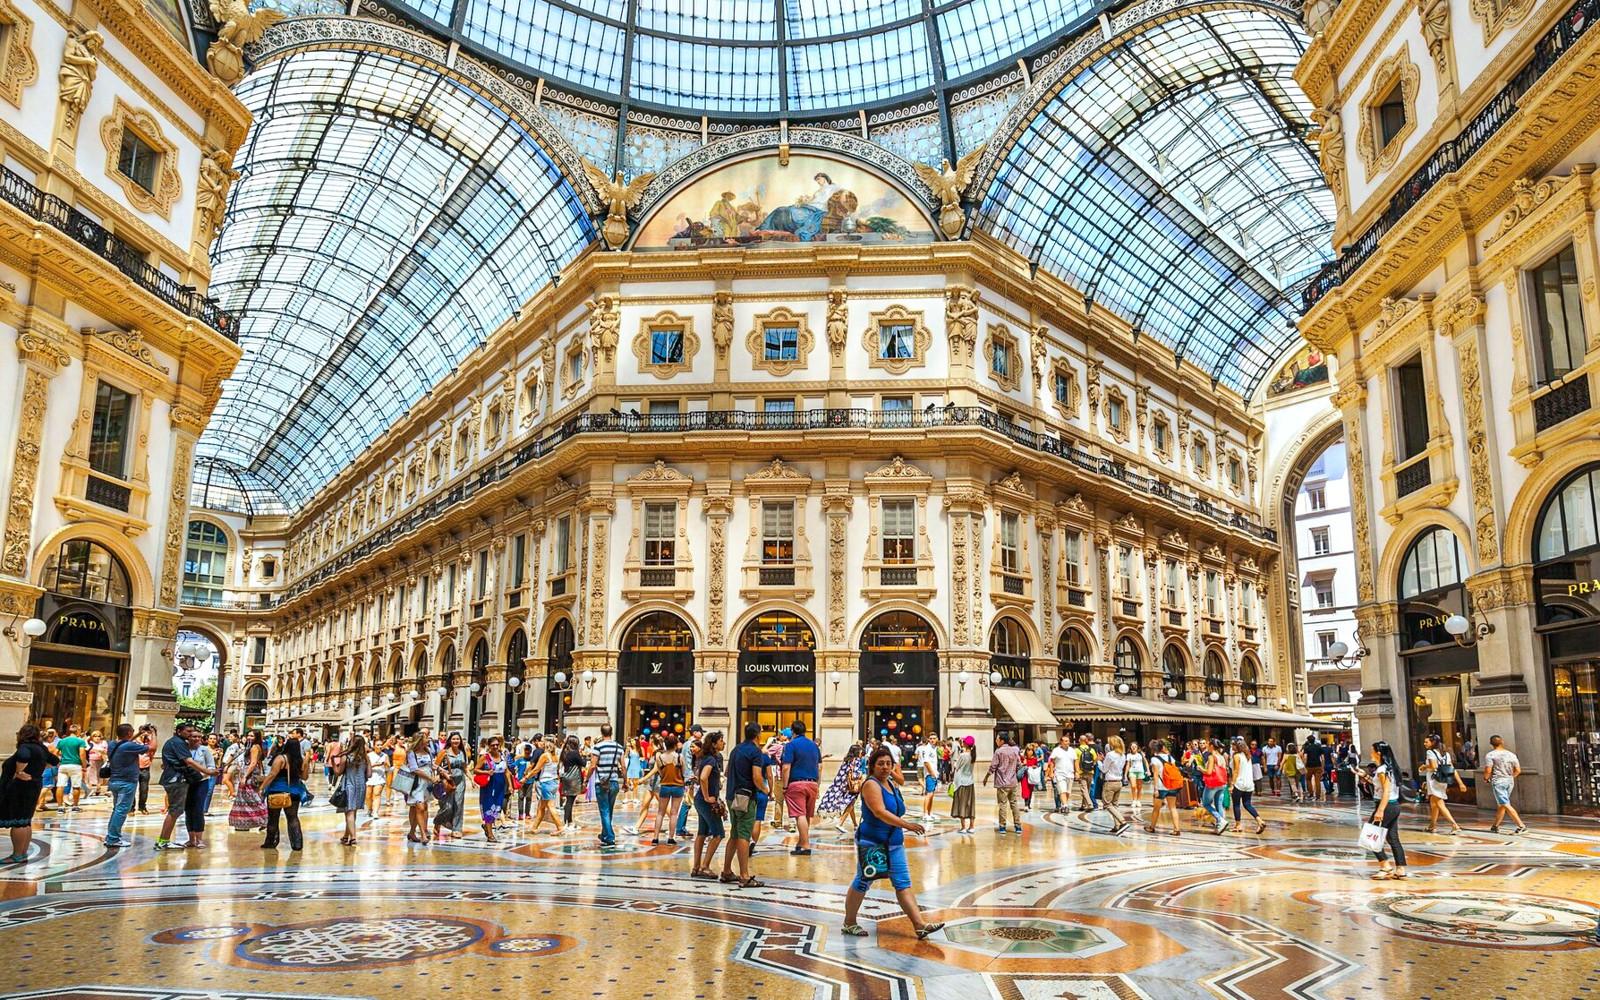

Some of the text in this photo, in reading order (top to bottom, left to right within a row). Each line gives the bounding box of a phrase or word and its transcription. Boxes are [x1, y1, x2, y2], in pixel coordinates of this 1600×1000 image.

[60, 615, 105, 631] PRADA
[1419, 612, 1455, 629] PRAD
[745, 664, 809, 673] LOUIS VUITTON
